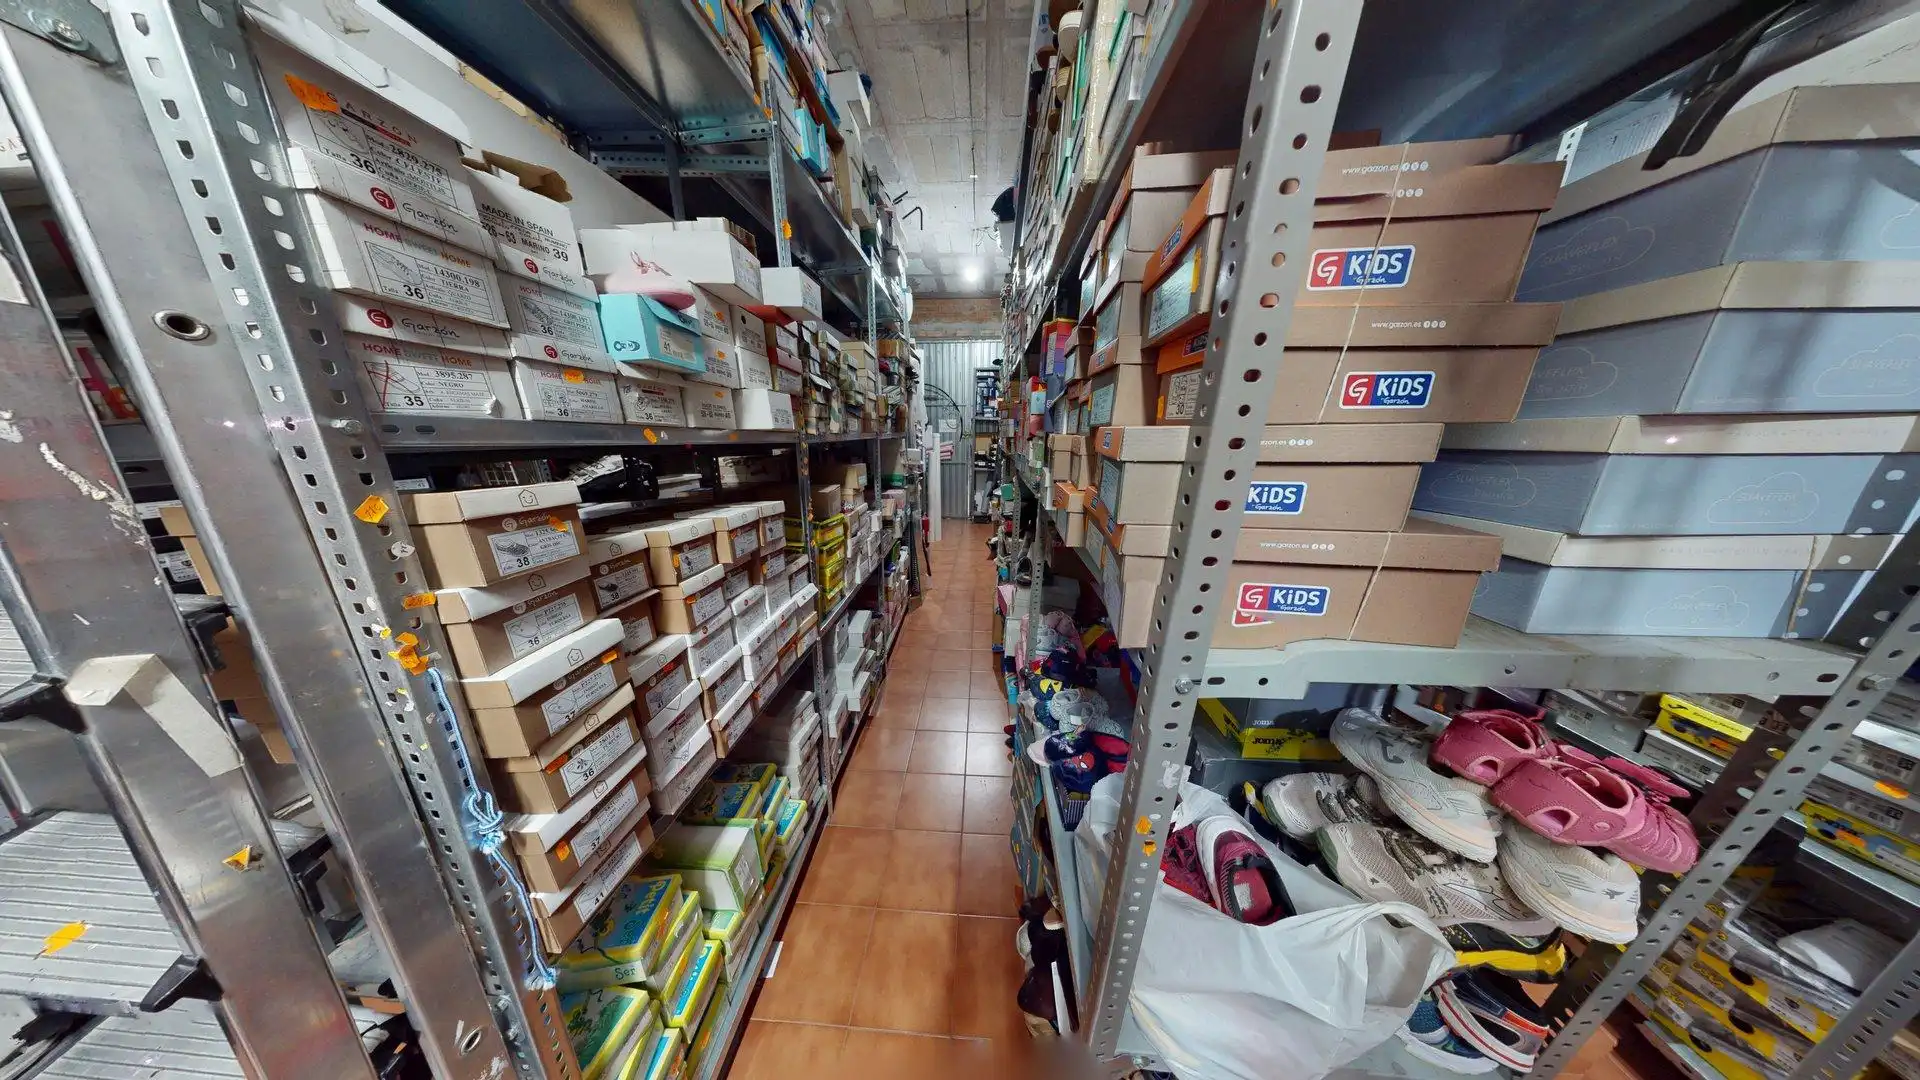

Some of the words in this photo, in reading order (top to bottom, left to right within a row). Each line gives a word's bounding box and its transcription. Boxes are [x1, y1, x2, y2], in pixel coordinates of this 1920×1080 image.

[350, 152, 376, 174] 36
[481, 203, 512, 220] MADE
[514, 217, 524, 226] IN
[526, 220, 554, 237] SPAIN
[364, 222, 402, 243] HOME
[552, 248, 569, 262] 39
[402, 284, 424, 300] 36
[540, 324, 554, 336] 36
[404, 396, 424, 407] 35
[557, 408, 570, 417] 36
[516, 556, 530, 568] 38
[528, 636, 540, 648] 36
[565, 710, 576, 724] 37
[582, 768, 594, 781] 36
